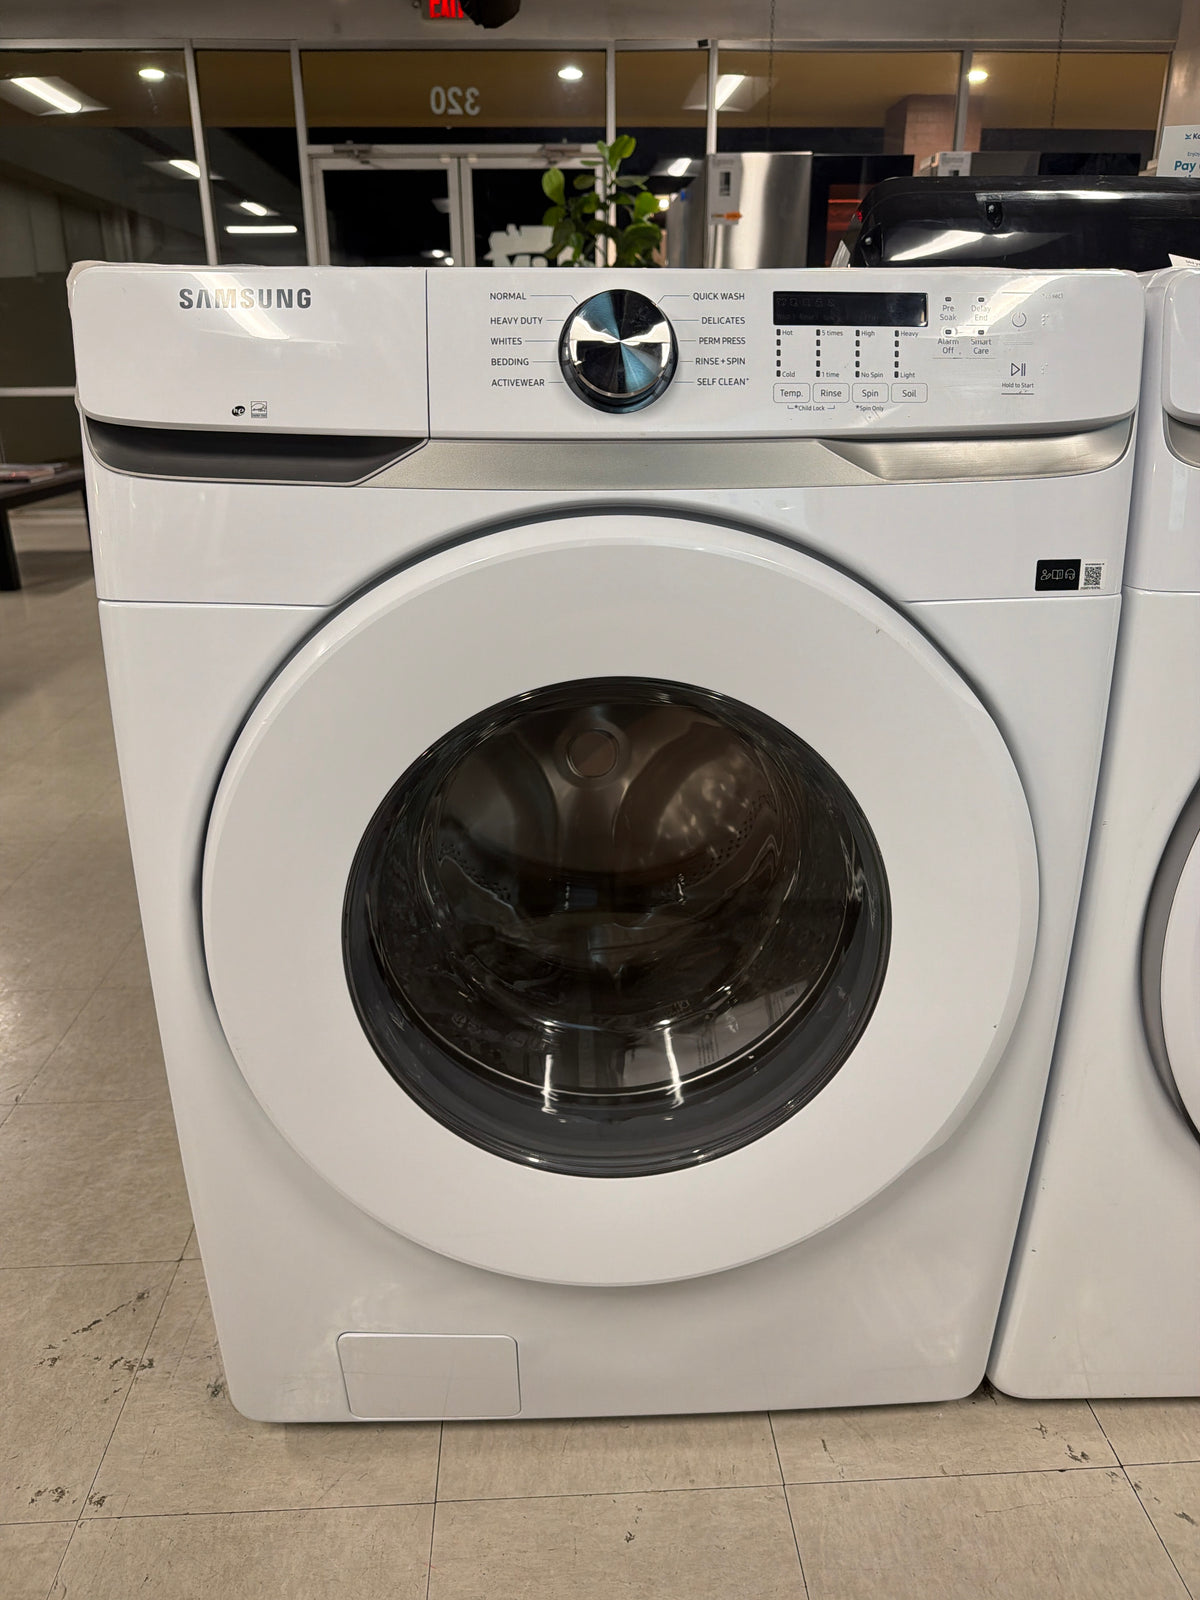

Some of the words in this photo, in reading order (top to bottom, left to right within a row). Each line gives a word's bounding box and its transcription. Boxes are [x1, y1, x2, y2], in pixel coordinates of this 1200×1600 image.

[1174, 160, 1196, 172] Pay
[179, 289, 312, 309] SAMSUNG
[693, 293, 719, 301] QUICK
[971, 305, 991, 313] Delay
[490, 317, 519, 325] HEAVY
[520, 317, 543, 325] DUTY
[491, 337, 522, 345] WHITES
[699, 337, 720, 345] PERM
[721, 337, 746, 345] PRESS
[491, 358, 529, 366] BEDDING
[697, 378, 717, 386] SELF
[780, 389, 803, 398] Temp.
[821, 389, 842, 397] Rinse
[862, 390, 879, 399] Spin
